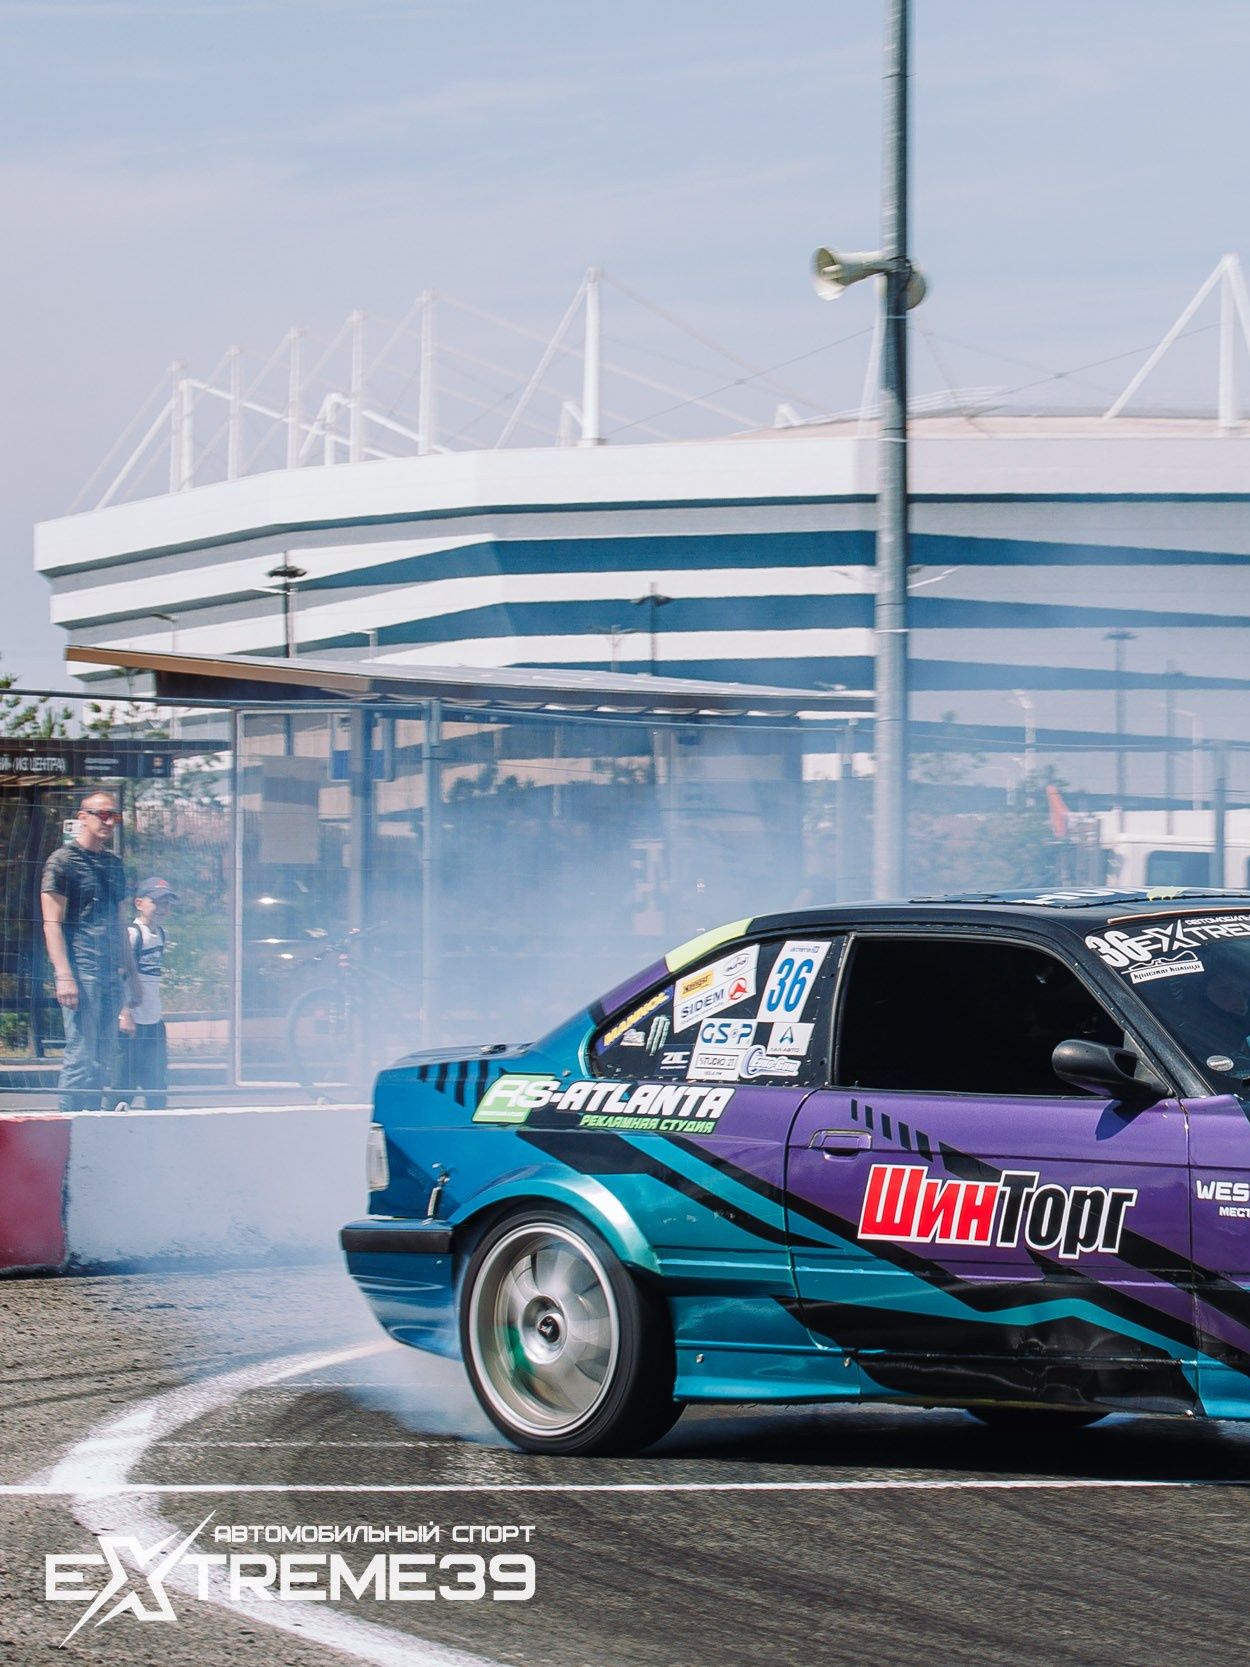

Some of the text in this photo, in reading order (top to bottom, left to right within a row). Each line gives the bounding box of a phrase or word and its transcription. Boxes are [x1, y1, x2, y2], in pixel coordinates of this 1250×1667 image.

[1085, 930, 1152, 968] 36
[681, 988, 725, 1019] SIDEM
[766, 957, 814, 1012] 36
[579, 1114, 716, 1134] РЕКЛАМНАЯ СТУДИЯ
[857, 1164, 1138, 1259] ШинТорг
